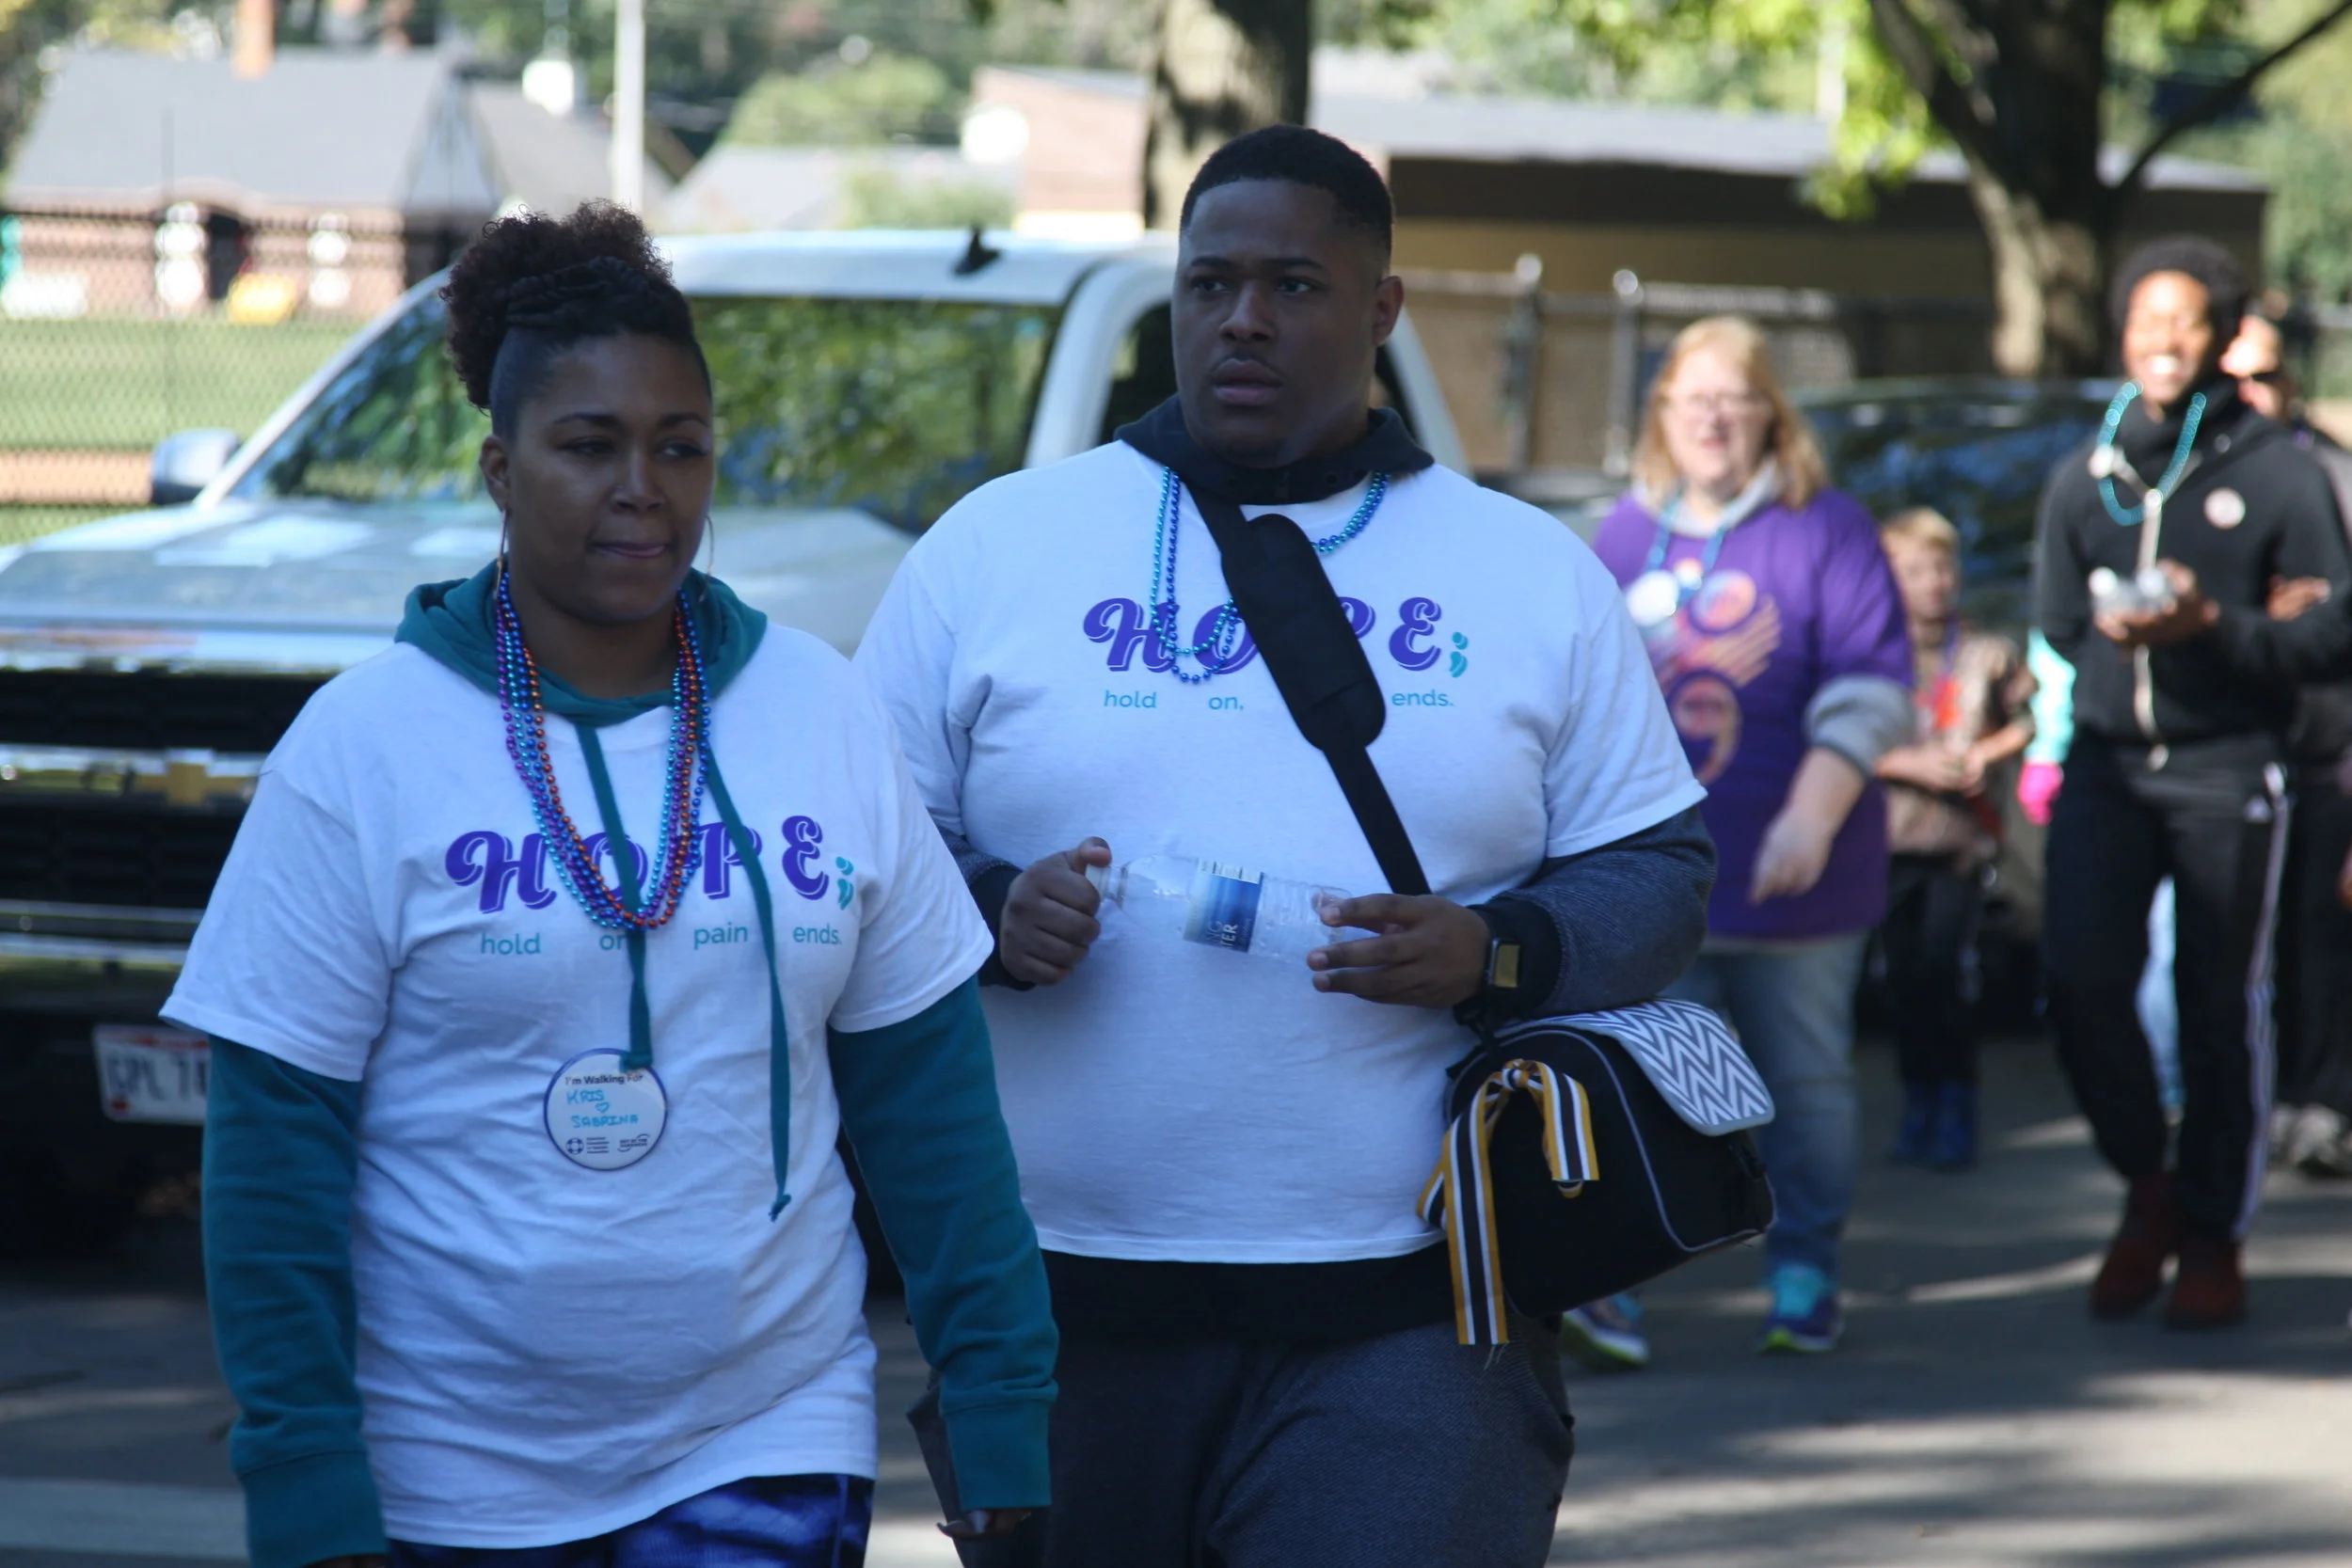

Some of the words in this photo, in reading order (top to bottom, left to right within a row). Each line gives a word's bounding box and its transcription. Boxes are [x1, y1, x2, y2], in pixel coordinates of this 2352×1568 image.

[1104, 690, 1156, 708] hold
[1391, 689, 1454, 707] ends.
[481, 933, 541, 955] hold
[694, 923, 749, 949] pain
[583, 1074, 625, 1085] Walking
[566, 1090, 605, 1104] KRIS
[570, 1115, 639, 1128] SABRINA
